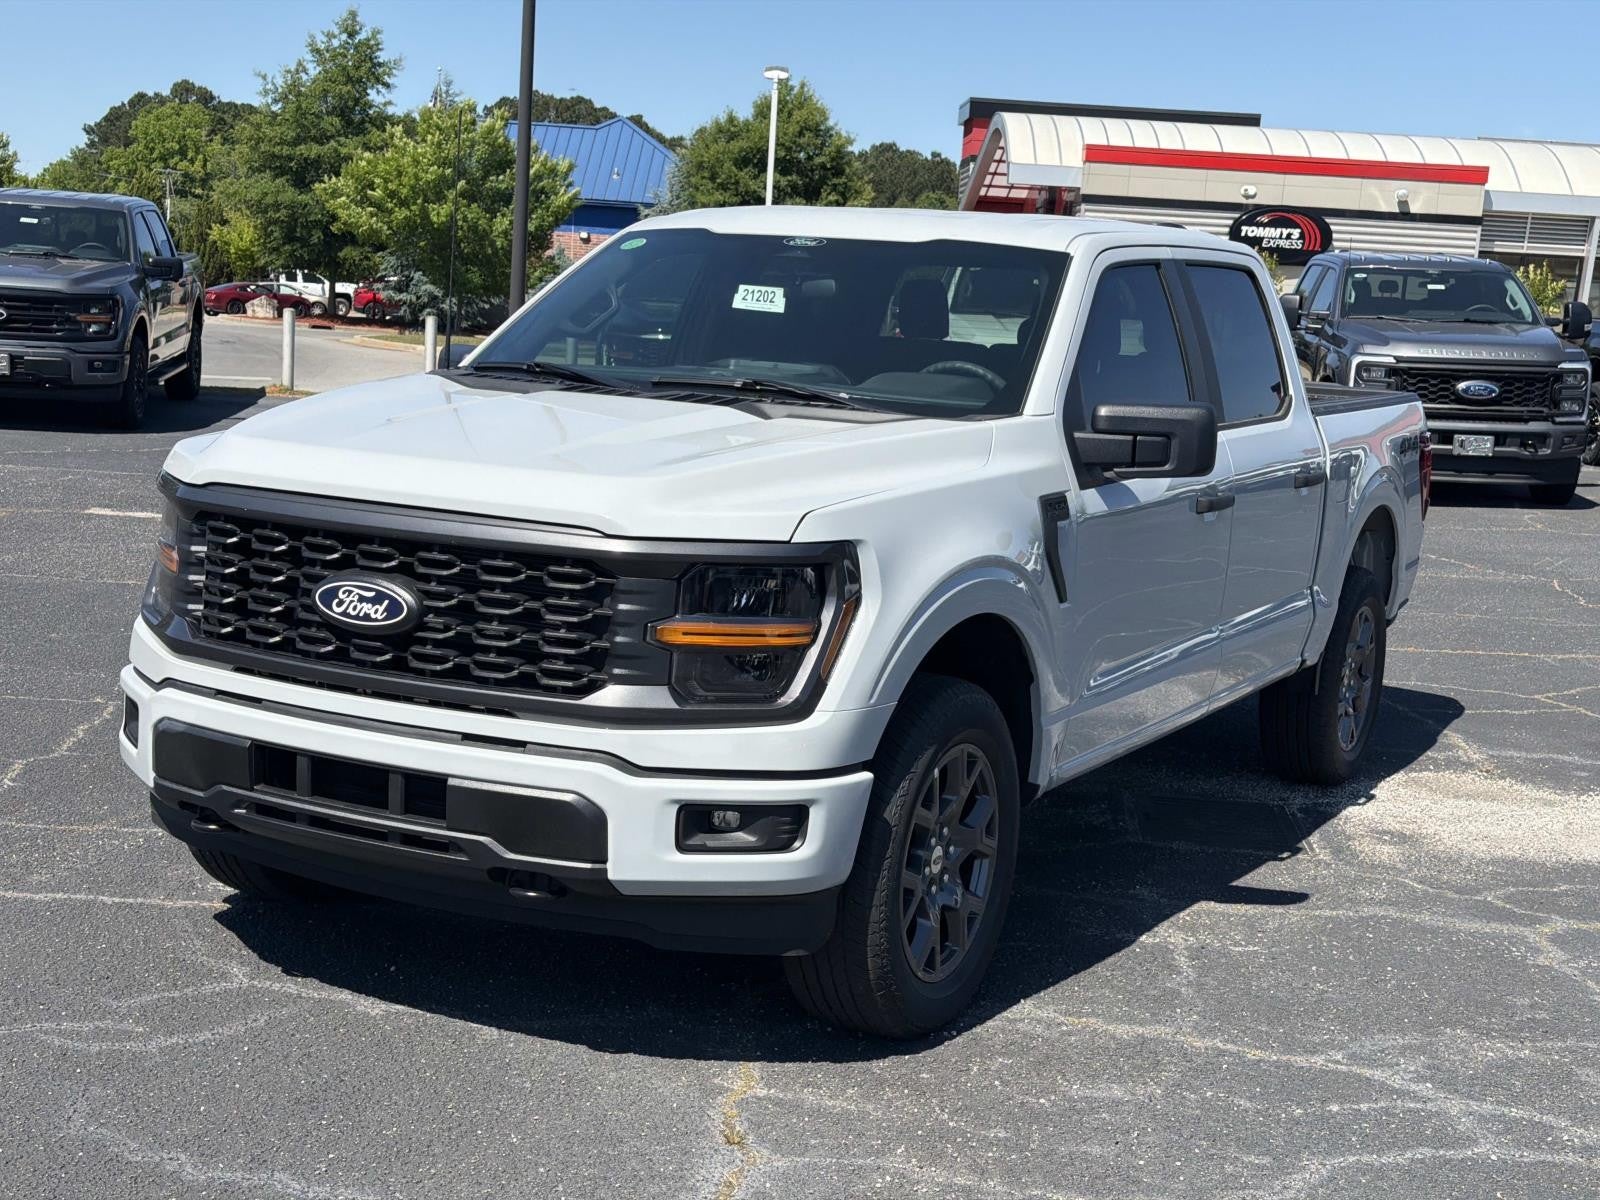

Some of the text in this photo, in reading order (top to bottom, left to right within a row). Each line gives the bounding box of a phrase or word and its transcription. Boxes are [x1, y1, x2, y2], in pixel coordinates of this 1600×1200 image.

[1240, 225, 1302, 240] TOMMY'S
[1261, 238, 1304, 249] EXPRESS
[741, 288, 777, 304] 21202
[331, 586, 389, 620] Ford
